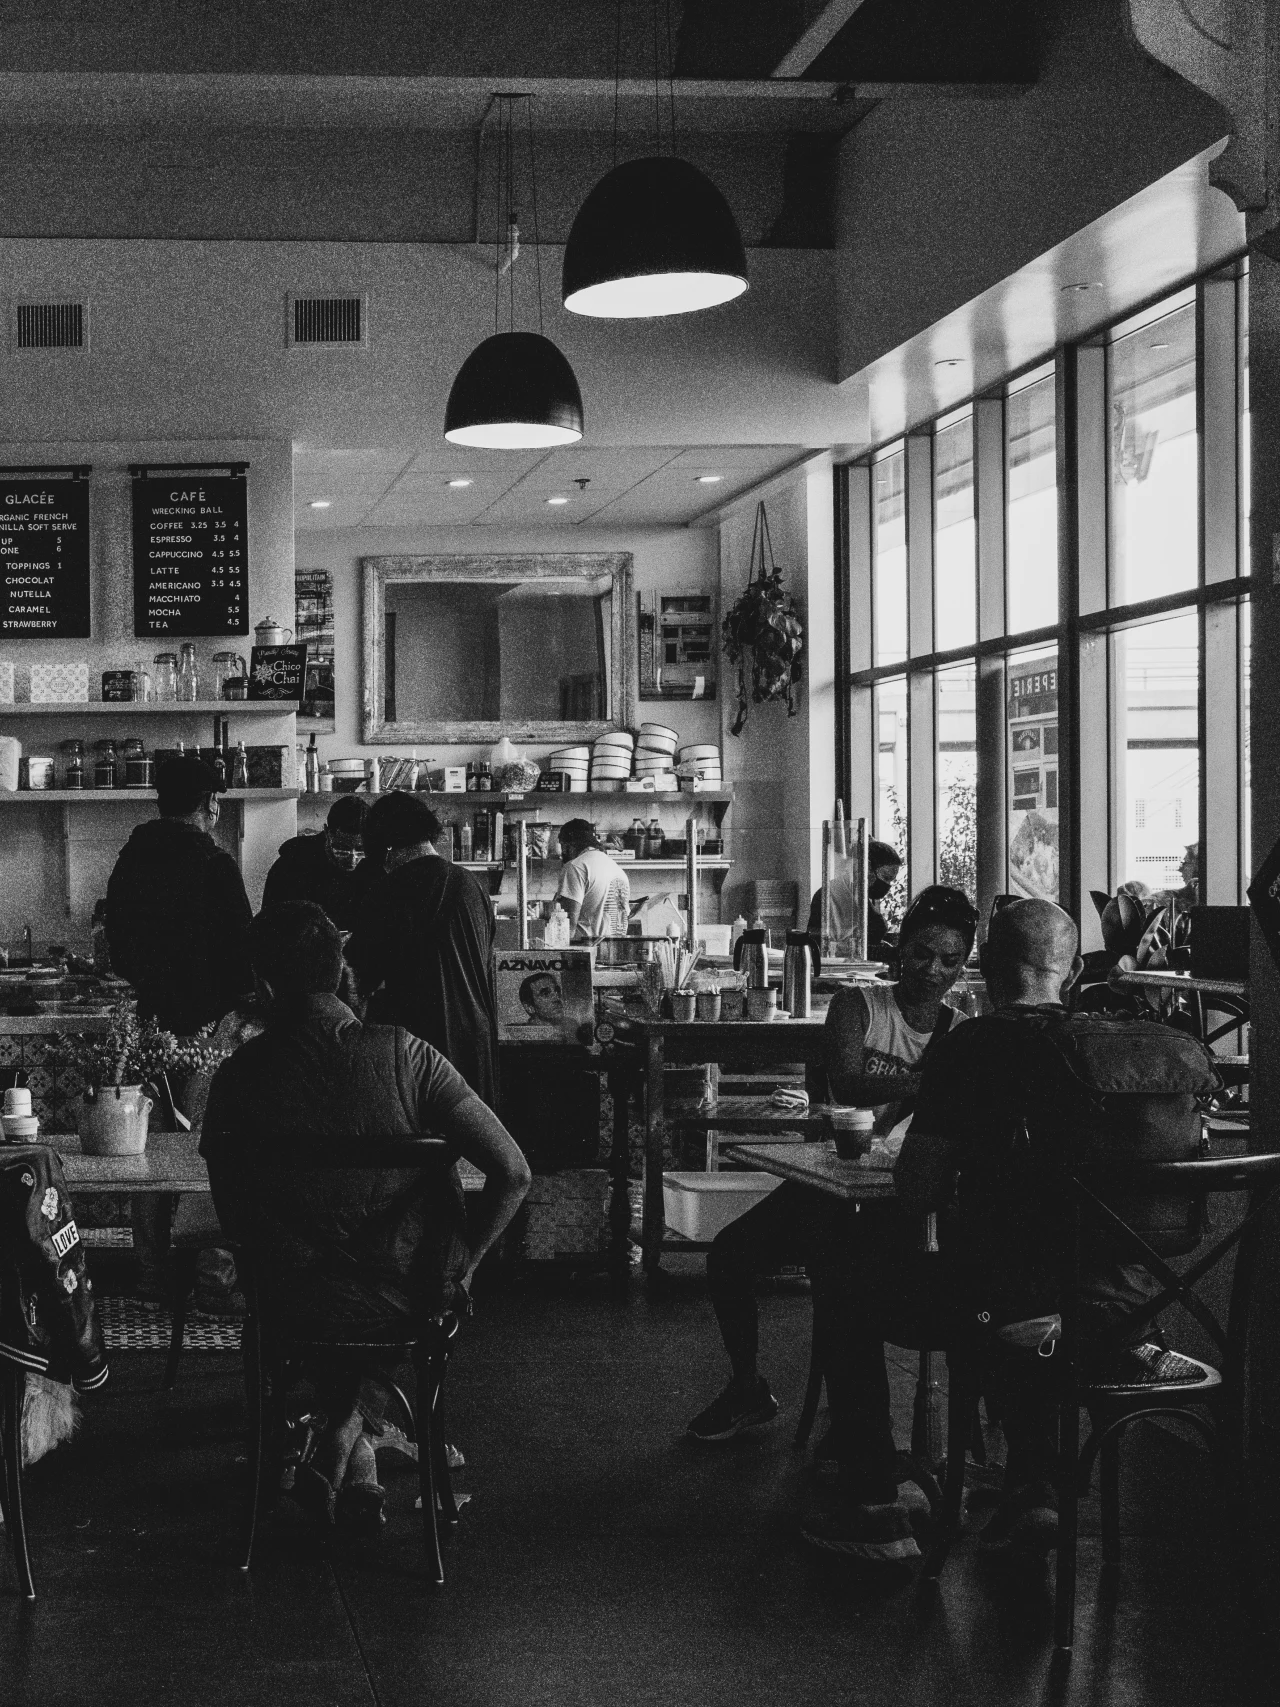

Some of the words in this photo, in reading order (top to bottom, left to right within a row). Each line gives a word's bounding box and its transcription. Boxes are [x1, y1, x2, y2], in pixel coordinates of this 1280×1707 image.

[5, 491, 54, 504] GLACÉE
[150, 522, 183, 530] COFFEE
[6, 562, 50, 570] TOPPINGS
[273, 660, 301, 671] Chico
[272, 672, 300, 684] Chai
[498, 959, 589, 972] AZNAVOUR
[53, 1224, 78, 1255] LOVE
